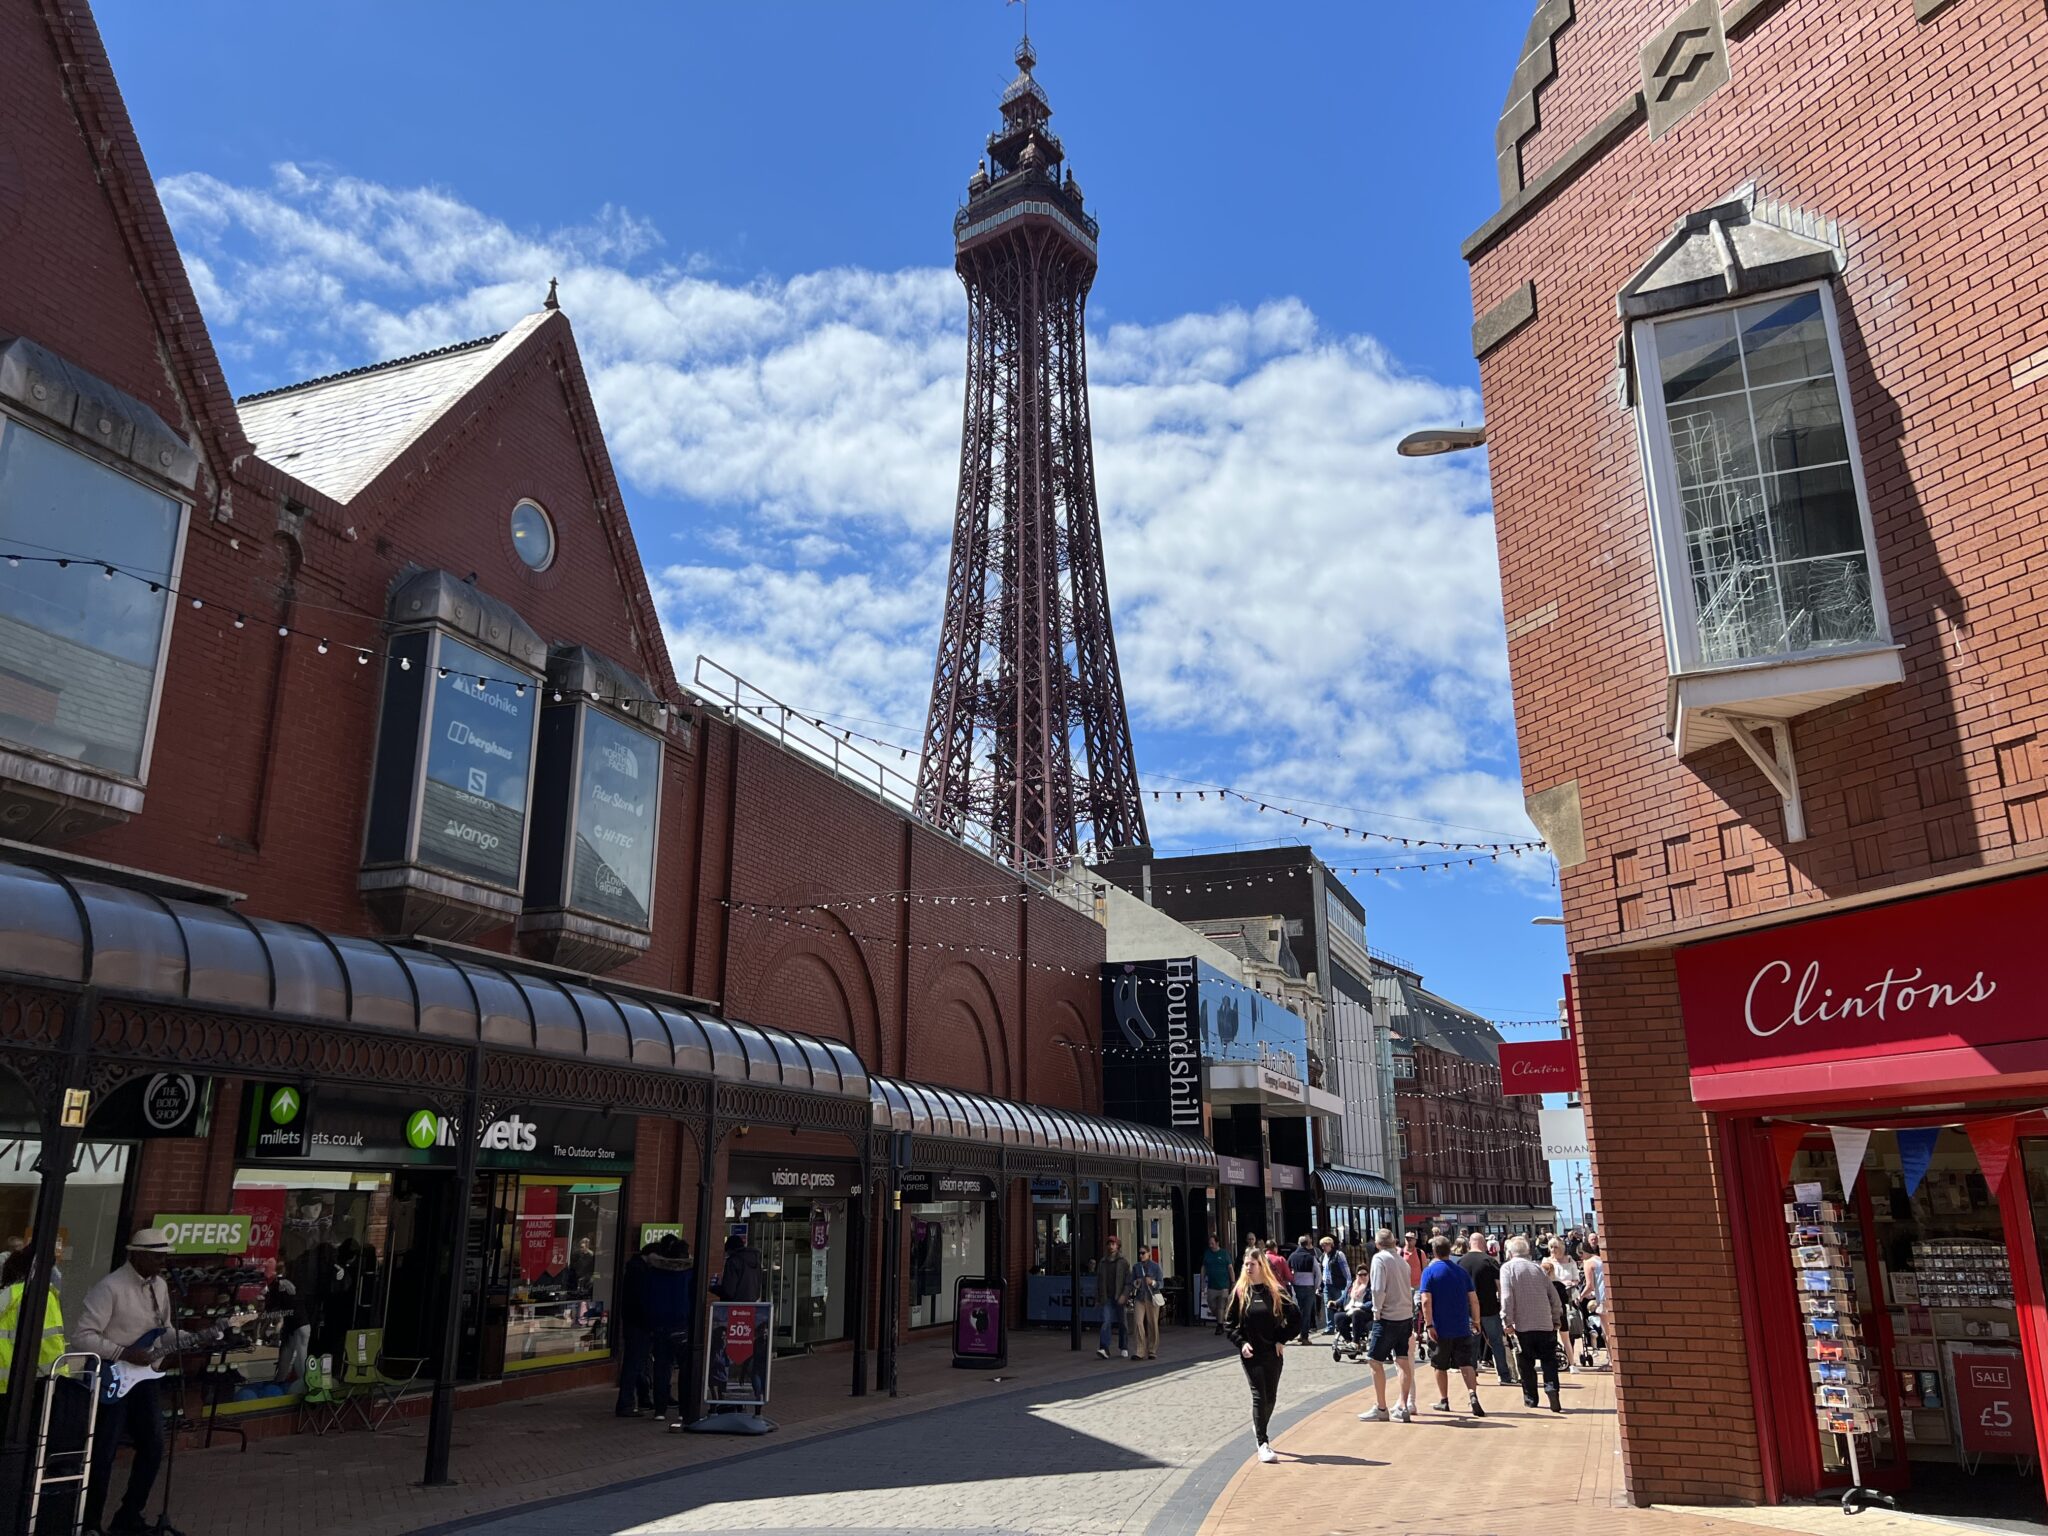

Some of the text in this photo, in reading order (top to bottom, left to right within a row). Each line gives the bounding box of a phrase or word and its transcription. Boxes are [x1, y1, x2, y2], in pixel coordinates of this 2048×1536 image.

[470, 683, 518, 717] Eurohike
[468, 731, 513, 760] berghaus
[613, 742, 626, 755] THE
[602, 746, 627, 765] NORTH
[608, 758, 626, 775] FACE
[592, 785, 635, 814] Peter Storm
[454, 820, 499, 850] Vango
[599, 881, 623, 897] alpine
[1744, 960, 1997, 1037] Clintons
[1166, 957, 1200, 1127] Houndshill
[1511, 1060, 1567, 1077] Clintons
[161, 1086, 179, 1096] THE
[156, 1098, 181, 1108] BODY
[155, 1109, 179, 1120] SHOP
[260, 1129, 300, 1144] millets
[311, 1131, 363, 1146] ets.co.uk
[553, 1145, 616, 1159] The Outdoor Store
[1547, 1143, 1589, 1154] ROMAN
[772, 1167, 835, 1189] vision express
[902, 1173, 925, 1182] vision
[938, 1176, 981, 1194] vision express
[900, 1182, 929, 1192] xpress
[526, 1220, 553, 1229] AMAZING
[163, 1222, 243, 1245] OFFERS
[525, 1230, 552, 1239] CAMPING
[529, 1240, 546, 1248] DEALS
[1048, 1295, 1097, 1308] NEO
[729, 1324, 752, 1337] 50%
[1976, 1372, 2006, 1383] SALE
[1980, 1400, 2013, 1427] £5
